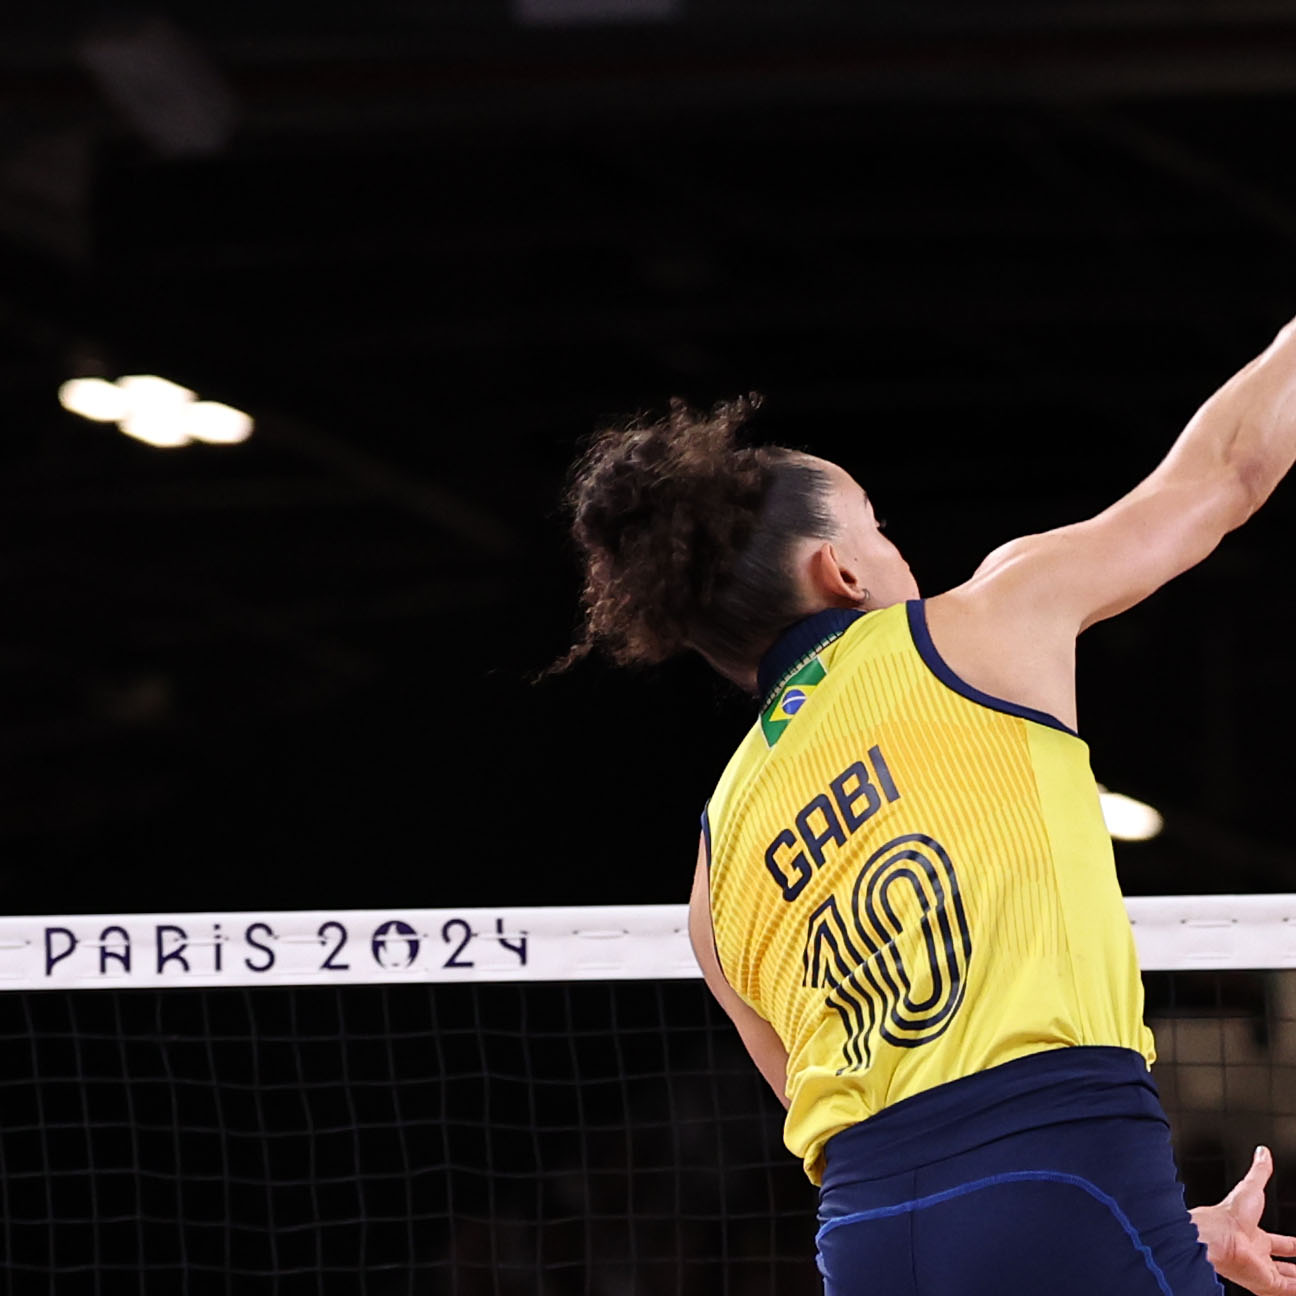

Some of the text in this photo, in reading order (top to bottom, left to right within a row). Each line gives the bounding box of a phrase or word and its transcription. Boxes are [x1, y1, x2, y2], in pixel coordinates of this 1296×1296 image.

[764, 745, 901, 902] GABI
[317, 919, 527, 972] 2024
[802, 833, 972, 1076] 10
